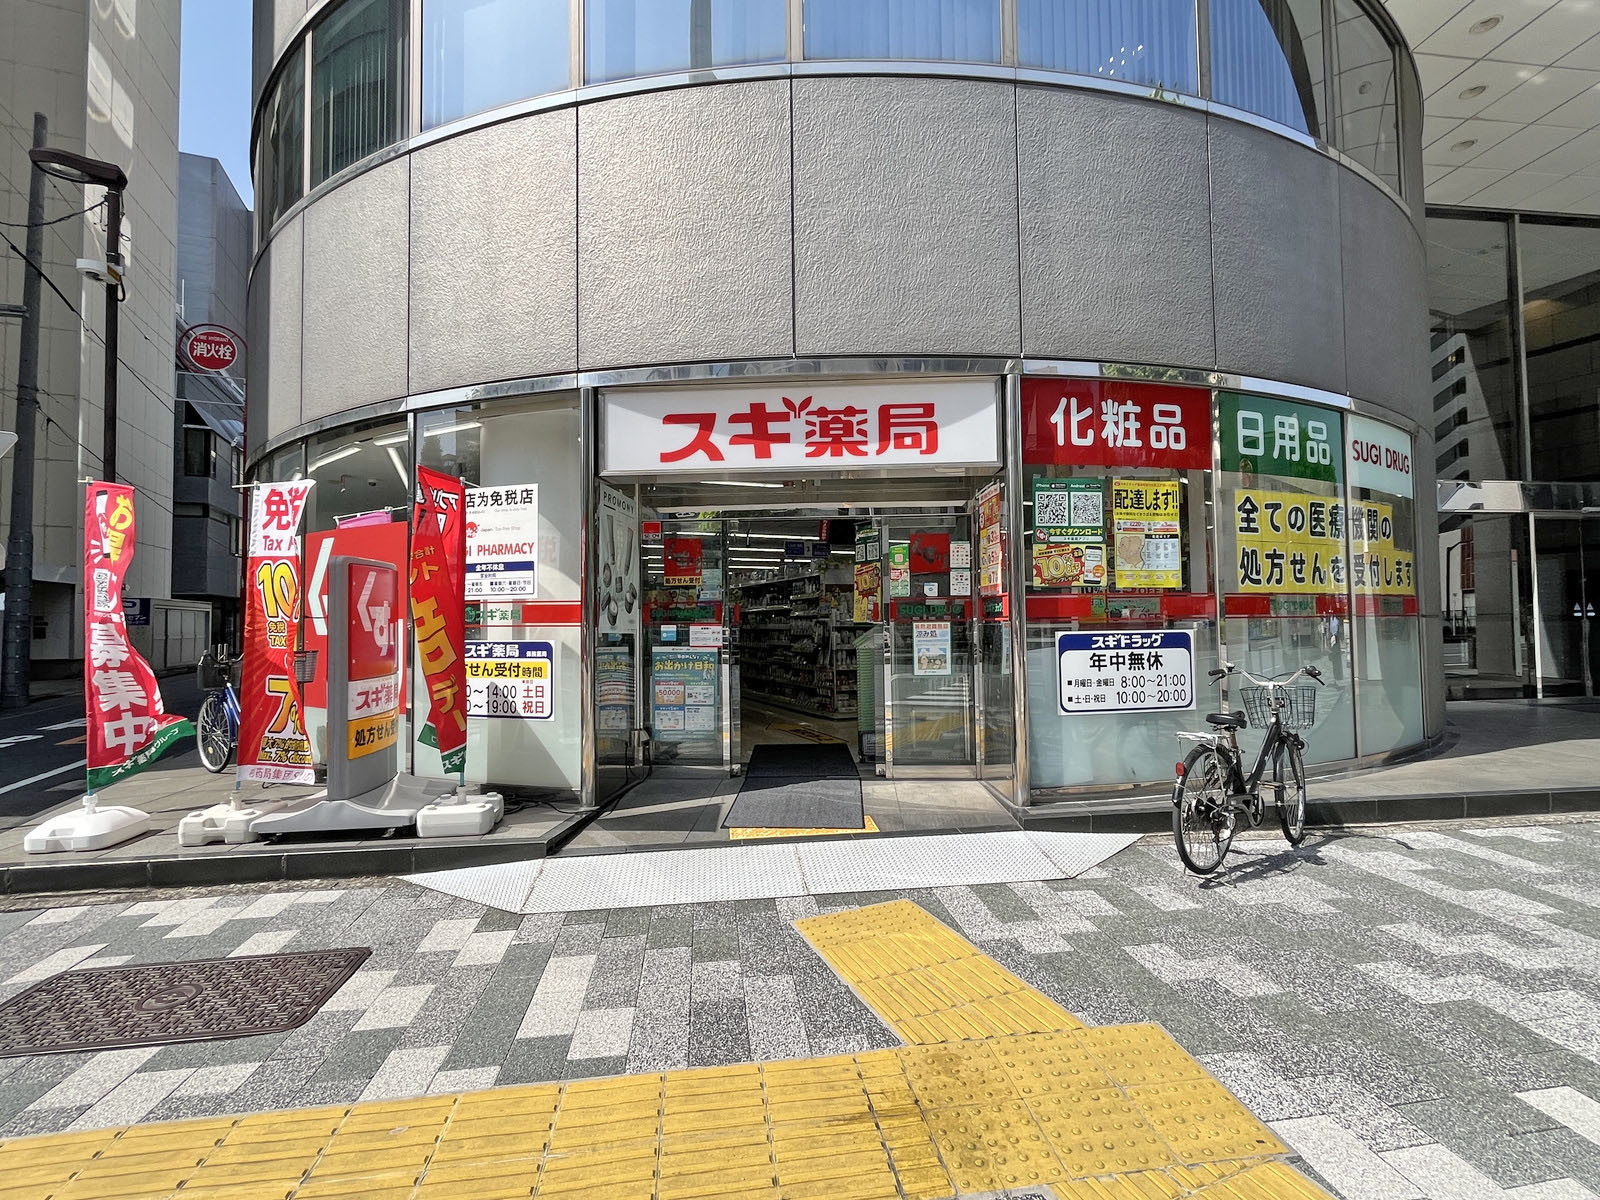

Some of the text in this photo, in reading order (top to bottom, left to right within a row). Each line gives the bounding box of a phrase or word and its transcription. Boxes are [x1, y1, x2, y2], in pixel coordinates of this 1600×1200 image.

[193, 341, 233, 360] 消火栓
[660, 395, 939, 463] スギ薬局
[1050, 396, 1187, 450] 化粧品
[1237, 409, 1331, 466] 日用品
[1352, 439, 1410, 474] SUGI DRUG
[1237, 496, 1392, 541] 全ての医療機関の
[1049, 528, 1103, 536] 今すぐダウンロード
[263, 535, 283, 551] Tax
[477, 542, 535, 557] PHARMACY
[1240, 547, 1412, 588] 処方せんを受付します
[476, 608, 521, 621] スギ薬局
[464, 643, 520, 657] スギ薬局
[1091, 633, 1164, 648] スギドラッグ
[1089, 651, 1164, 672] 年中無休
[90, 622, 151, 756] 募集中
[522, 685, 544, 698] 土日
[522, 701, 544, 714] 祝日
